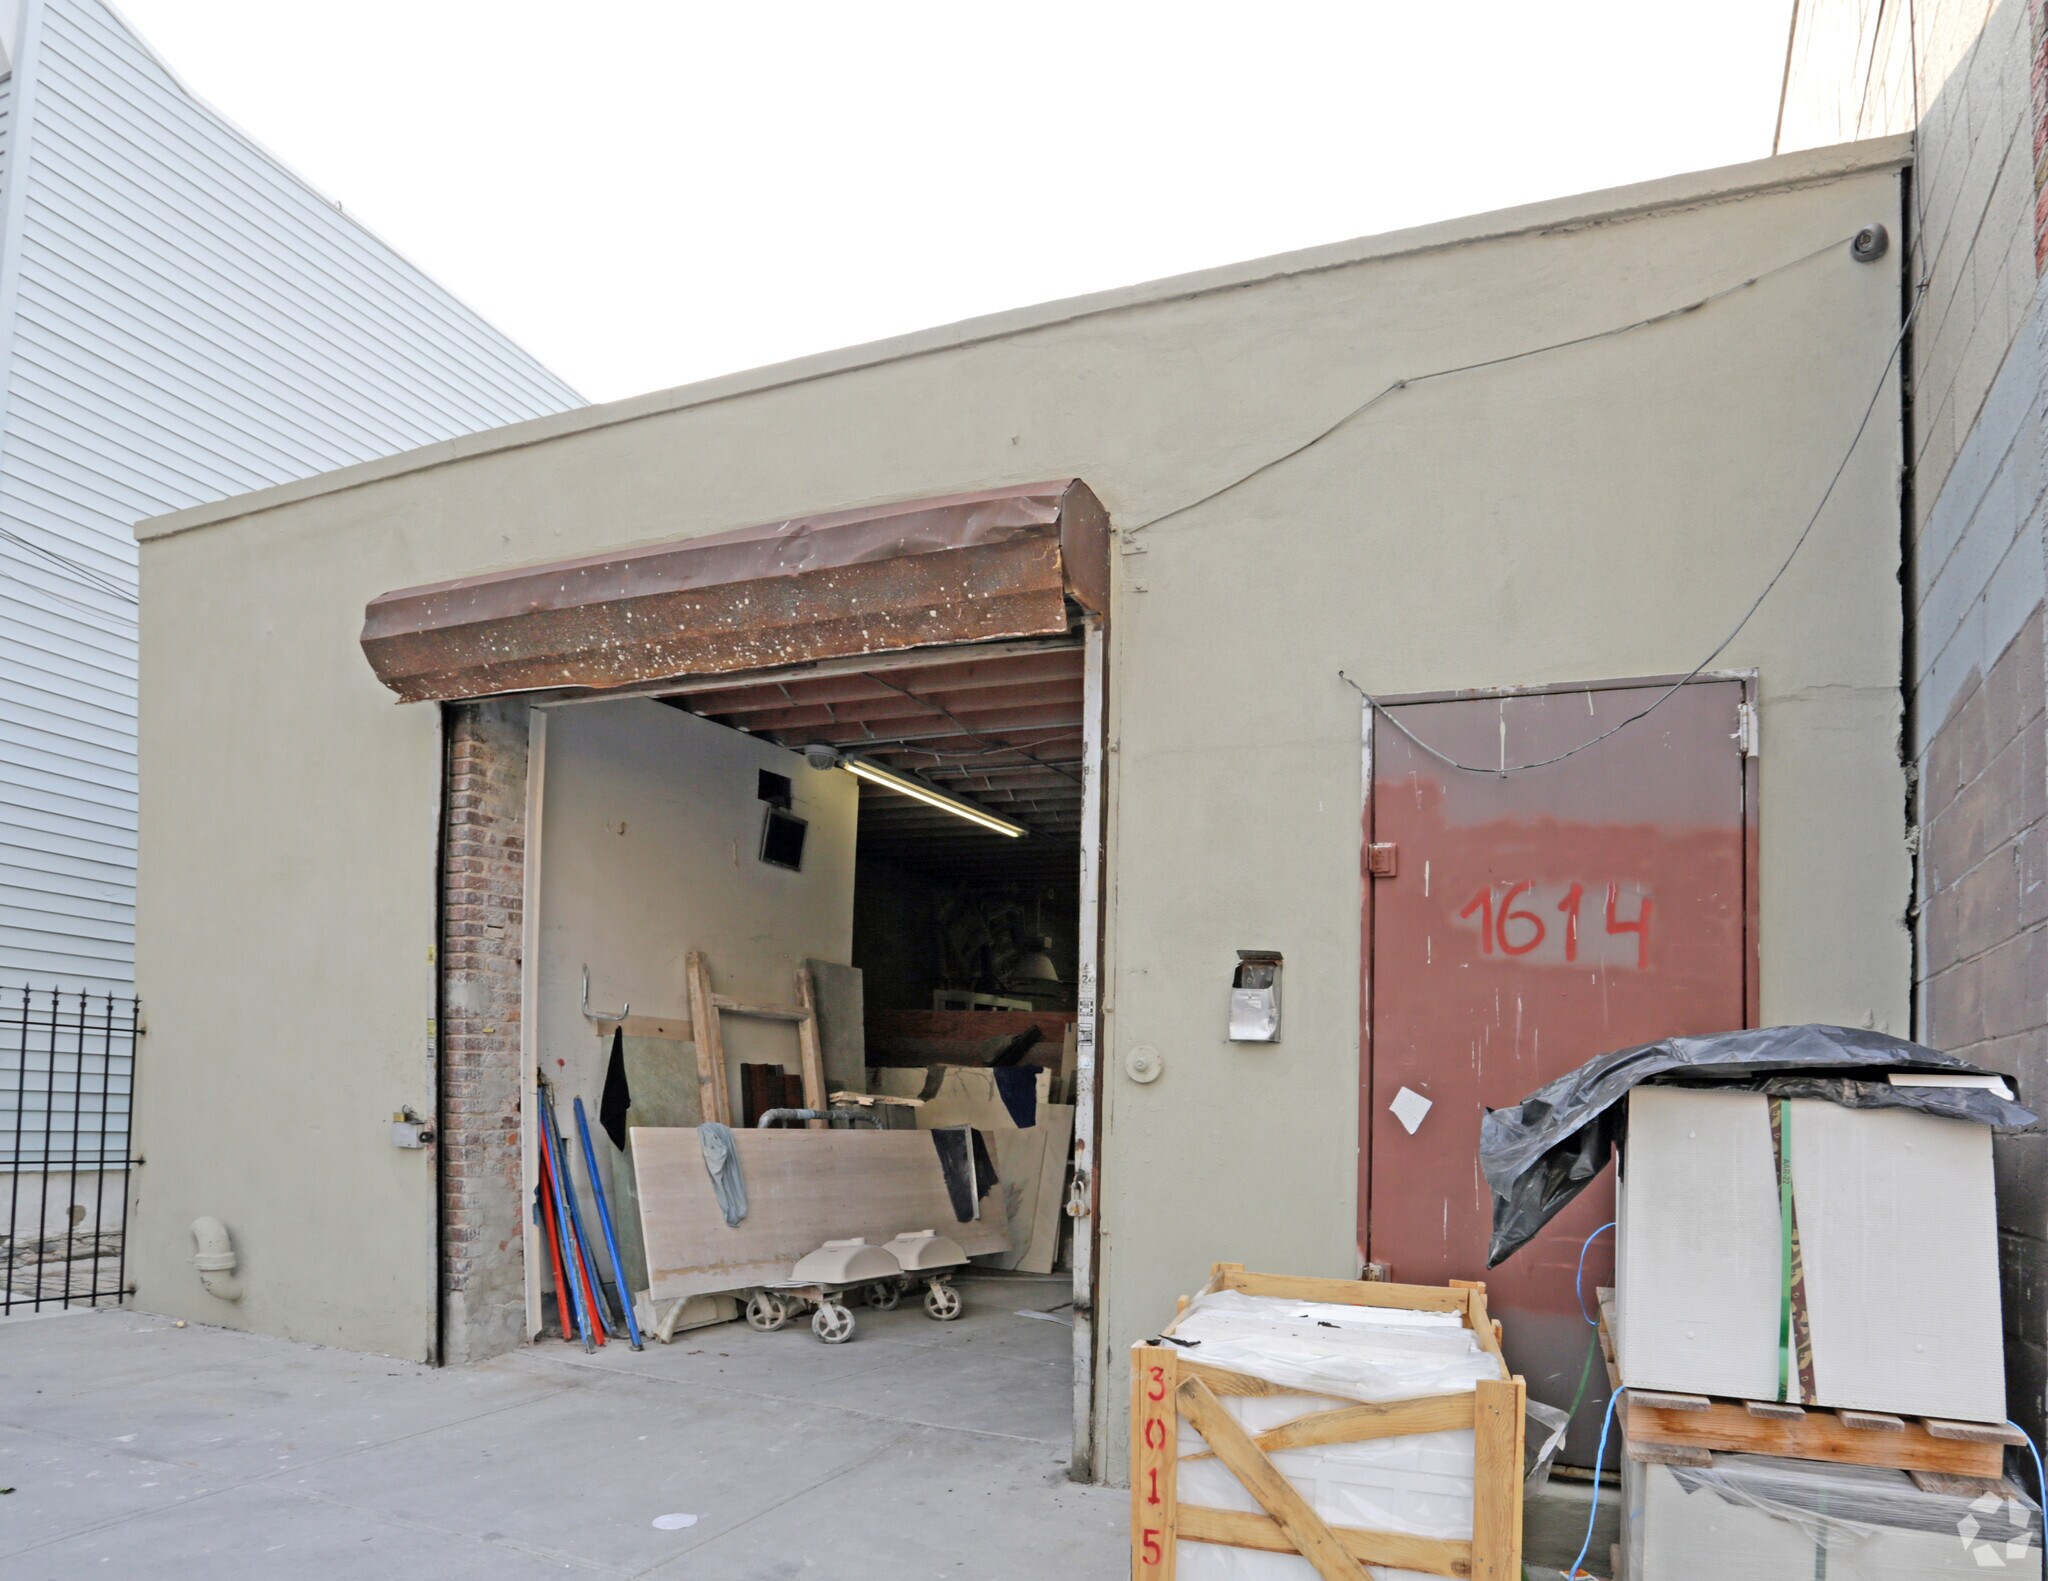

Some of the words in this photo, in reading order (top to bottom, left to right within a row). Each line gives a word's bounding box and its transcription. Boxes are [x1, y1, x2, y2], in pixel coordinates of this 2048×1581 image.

[1461, 880, 1653, 968] 1614
[1782, 1158, 1791, 1185] AAR-22
[1142, 1366, 1166, 1565] 3015
